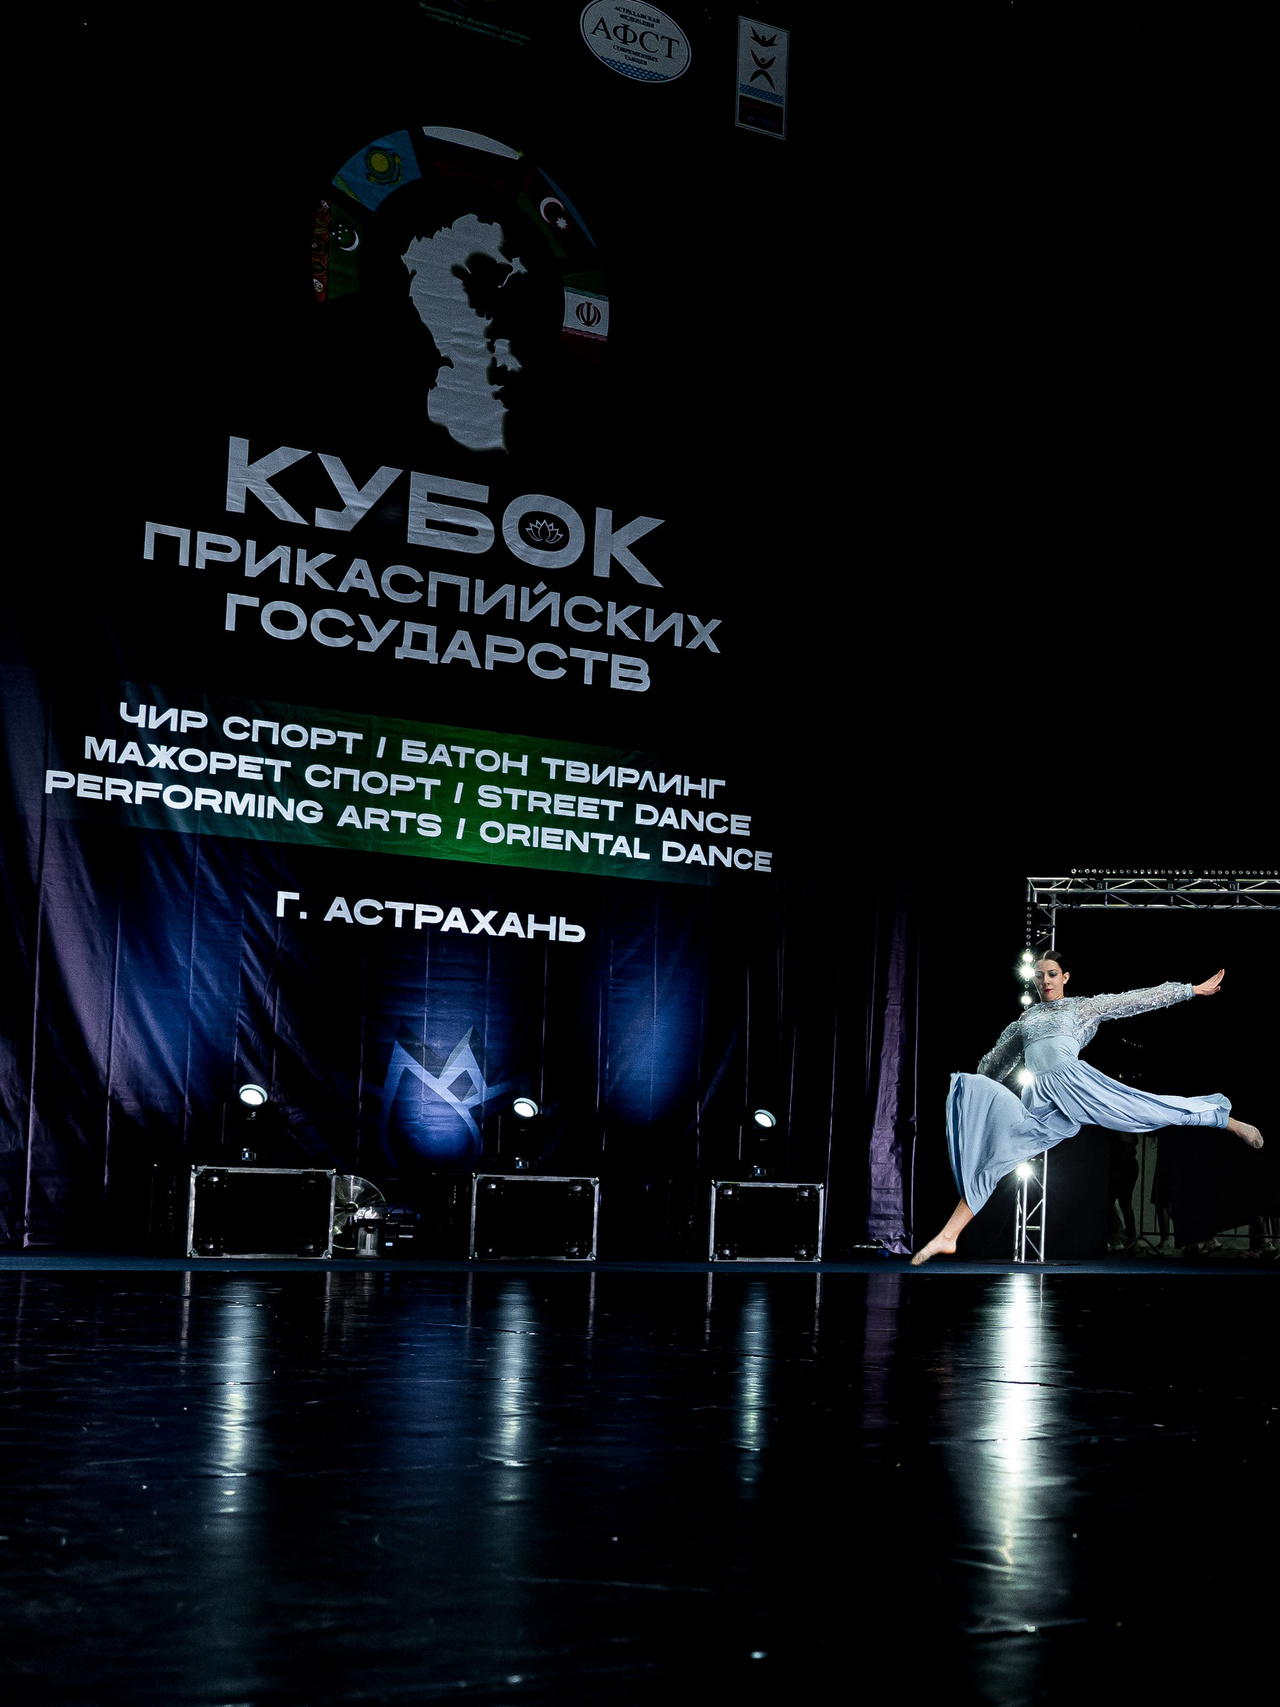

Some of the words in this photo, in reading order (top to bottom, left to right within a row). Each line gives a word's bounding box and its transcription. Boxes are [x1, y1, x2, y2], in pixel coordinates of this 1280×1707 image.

[590, 16, 680, 59] АФСТ
[225, 436, 665, 588] КУБОК
[143, 521, 723, 653] ПРИКАСПИЙСКИХ
[225, 593, 651, 692] ГОСУДАРСТВ
[85, 736, 292, 782] МАЖОРЕТ
[305, 764, 441, 800] СПОРТ
[478, 785, 623, 821] STREET
[635, 804, 751, 836] DANCE
[120, 702, 209, 733] ЧИР
[223, 716, 364, 754] СПОРТ
[402, 740, 528, 776] БАТОН
[542, 757, 726, 799] ТВИРЛИНГ
[45, 770, 324, 823] PERFORMING
[337, 805, 442, 837] ARTS
[480, 821, 650, 859] ORIENTAL
[662, 841, 773, 872] DANCE
[277, 891, 308, 919] Г.
[324, 897, 586, 942] АСТРАХАНЬ
